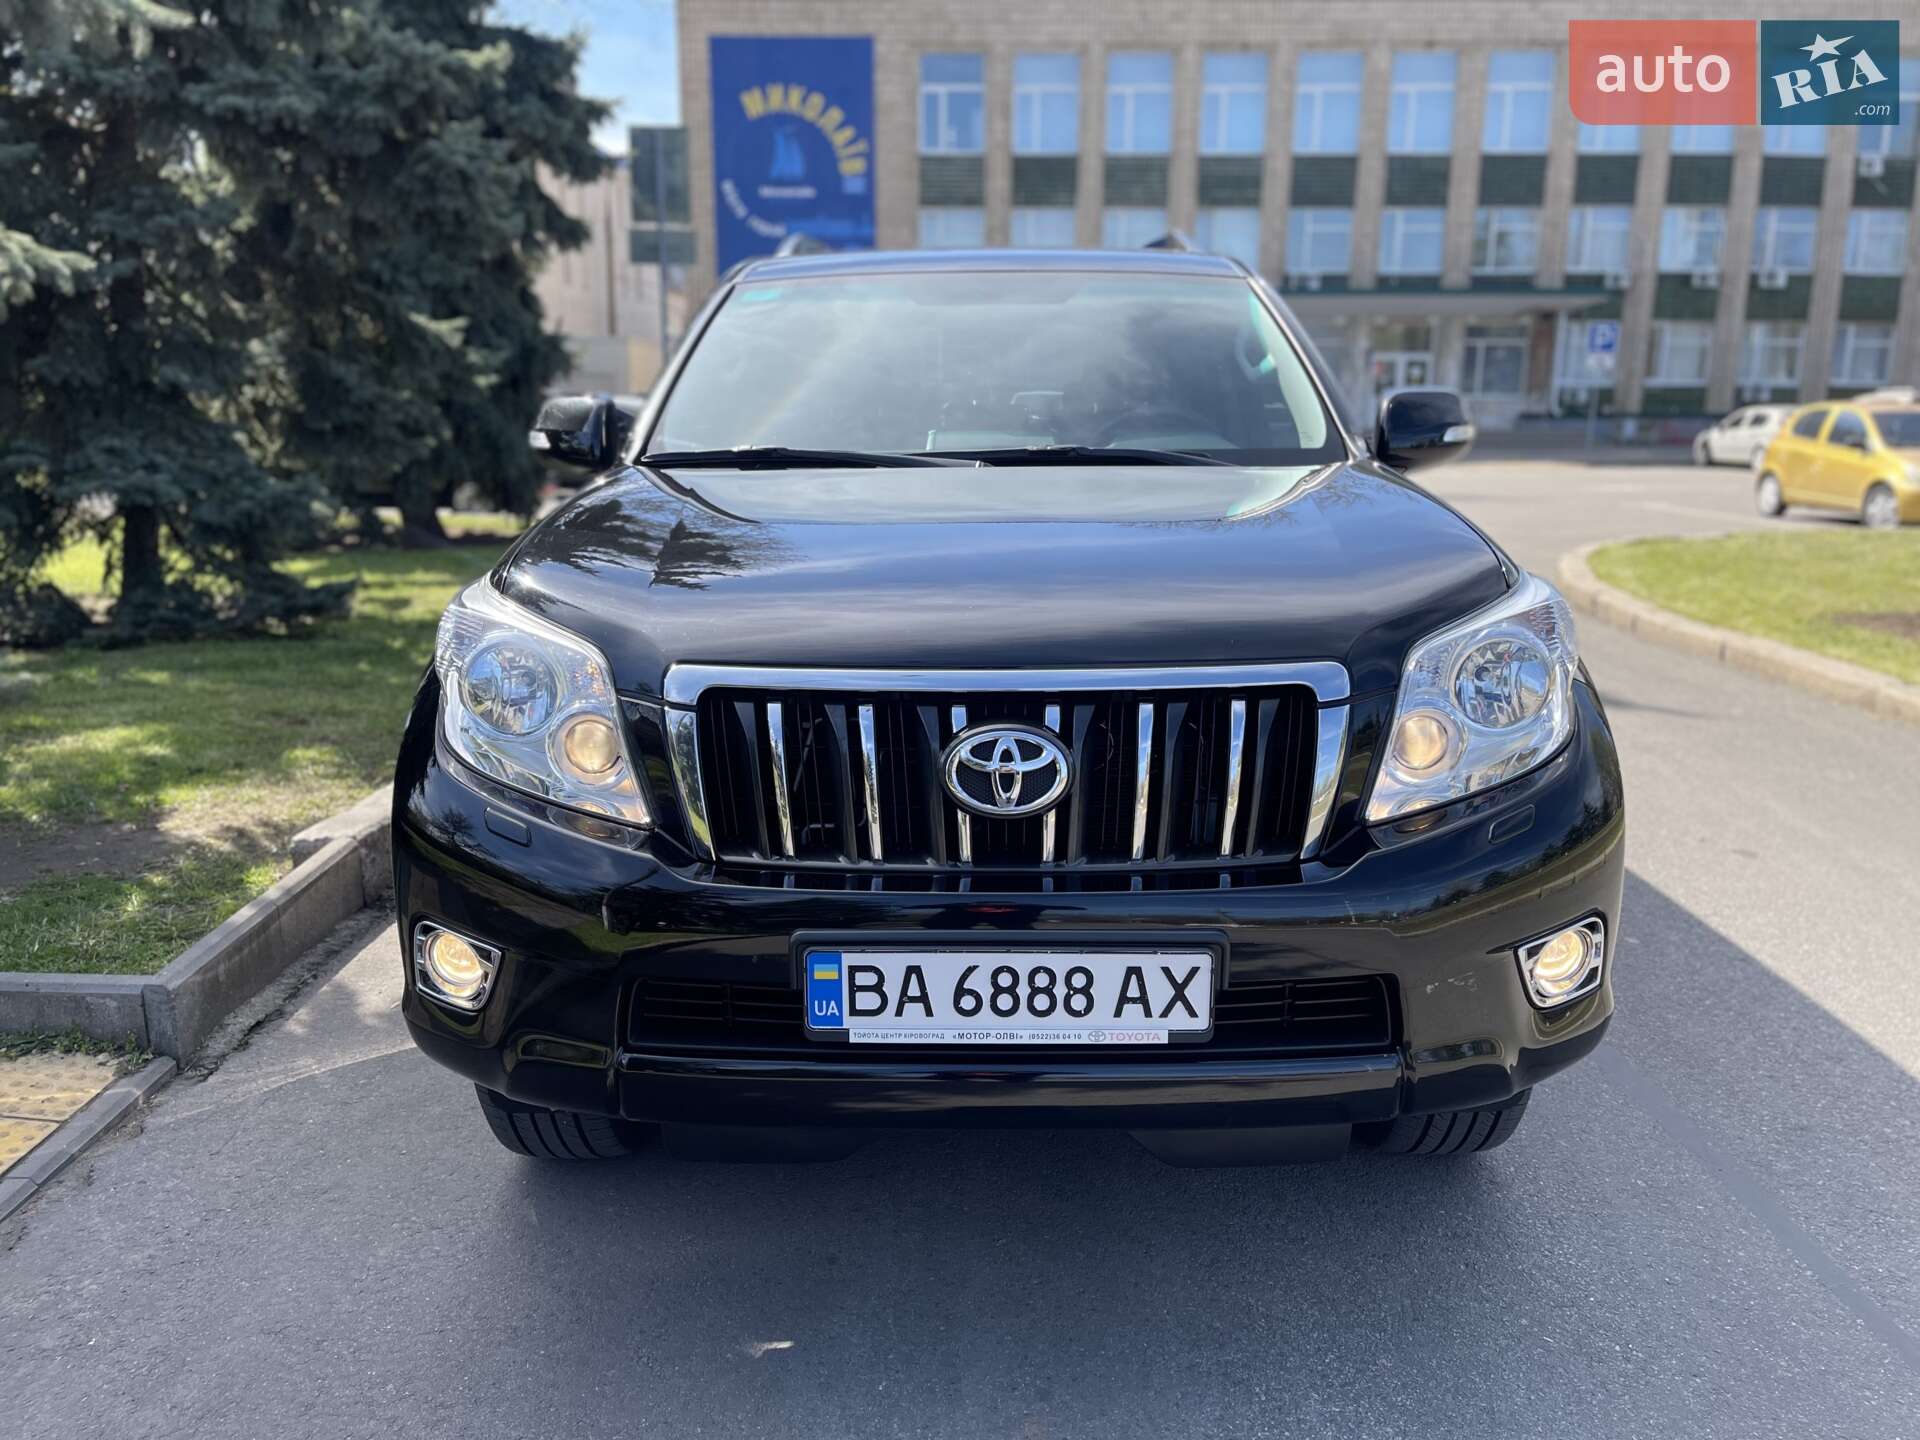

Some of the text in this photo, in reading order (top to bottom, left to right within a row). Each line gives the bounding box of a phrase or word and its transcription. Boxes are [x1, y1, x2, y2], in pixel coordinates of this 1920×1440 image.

[847, 964, 1201, 1019] BA 6888 AX
[814, 1001, 840, 1017] UA
[880, 1032, 902, 1040] ЦЕНТР
[1108, 1032, 1161, 1042] TOYOTA
